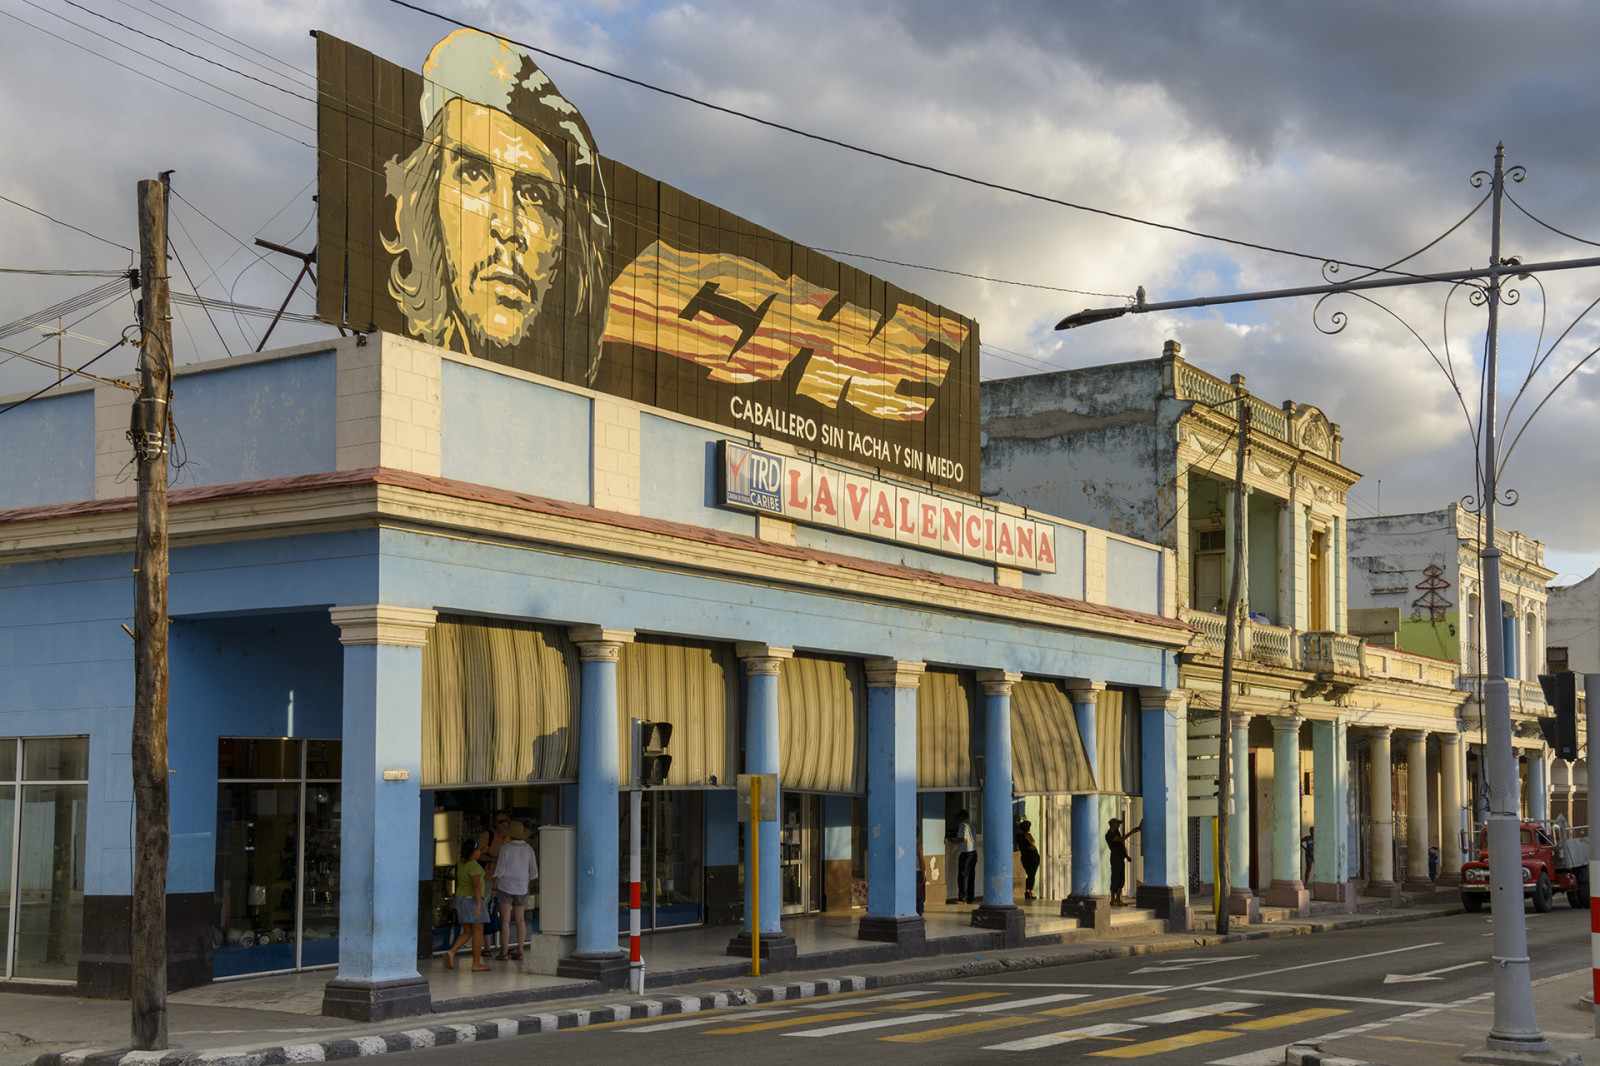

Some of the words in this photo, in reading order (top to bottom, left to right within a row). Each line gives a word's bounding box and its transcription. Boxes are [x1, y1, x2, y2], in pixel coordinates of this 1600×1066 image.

[730, 395, 817, 442] CABALLERO
[821, 423, 844, 449] SIN
[848, 430, 891, 463] TACHA
[893, 444, 902, 465] Y
[904, 447, 923, 472] SIN
[926, 453, 964, 483] MIEDO
[750, 492, 780, 512] CARIBE
[751, 454, 781, 493] TRD
[788, 469, 837, 516] LA
[846, 483, 1054, 564] VALENCIANA
